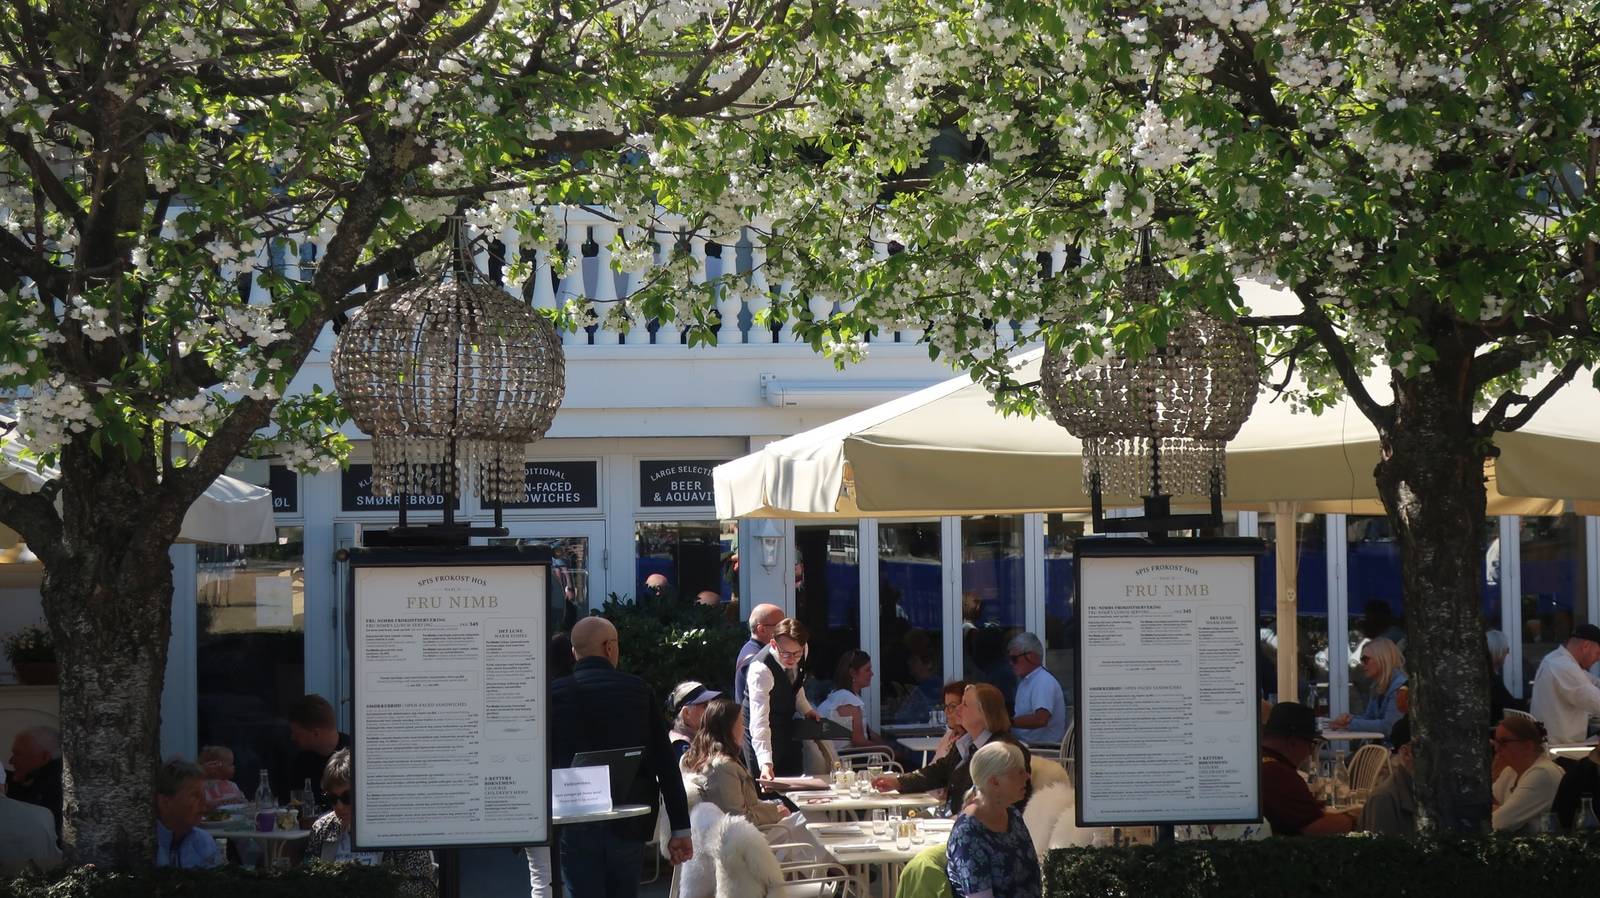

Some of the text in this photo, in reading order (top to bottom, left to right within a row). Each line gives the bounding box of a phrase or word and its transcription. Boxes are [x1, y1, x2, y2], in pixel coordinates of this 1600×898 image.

[523, 468, 566, 480] DITIONAL
[650, 466, 714, 481] LARGE SELECTI
[523, 482, 572, 492] N-FACED
[671, 481, 702, 491] BEER
[523, 492, 581, 503] DWICHES
[653, 492, 714, 502] & AQUAVI
[435, 575, 470, 583] FROKOST
[471, 577, 488, 587] HOS
[1125, 584, 1210, 597] FRU NIMB
[406, 595, 499, 609] FRU NIMB
